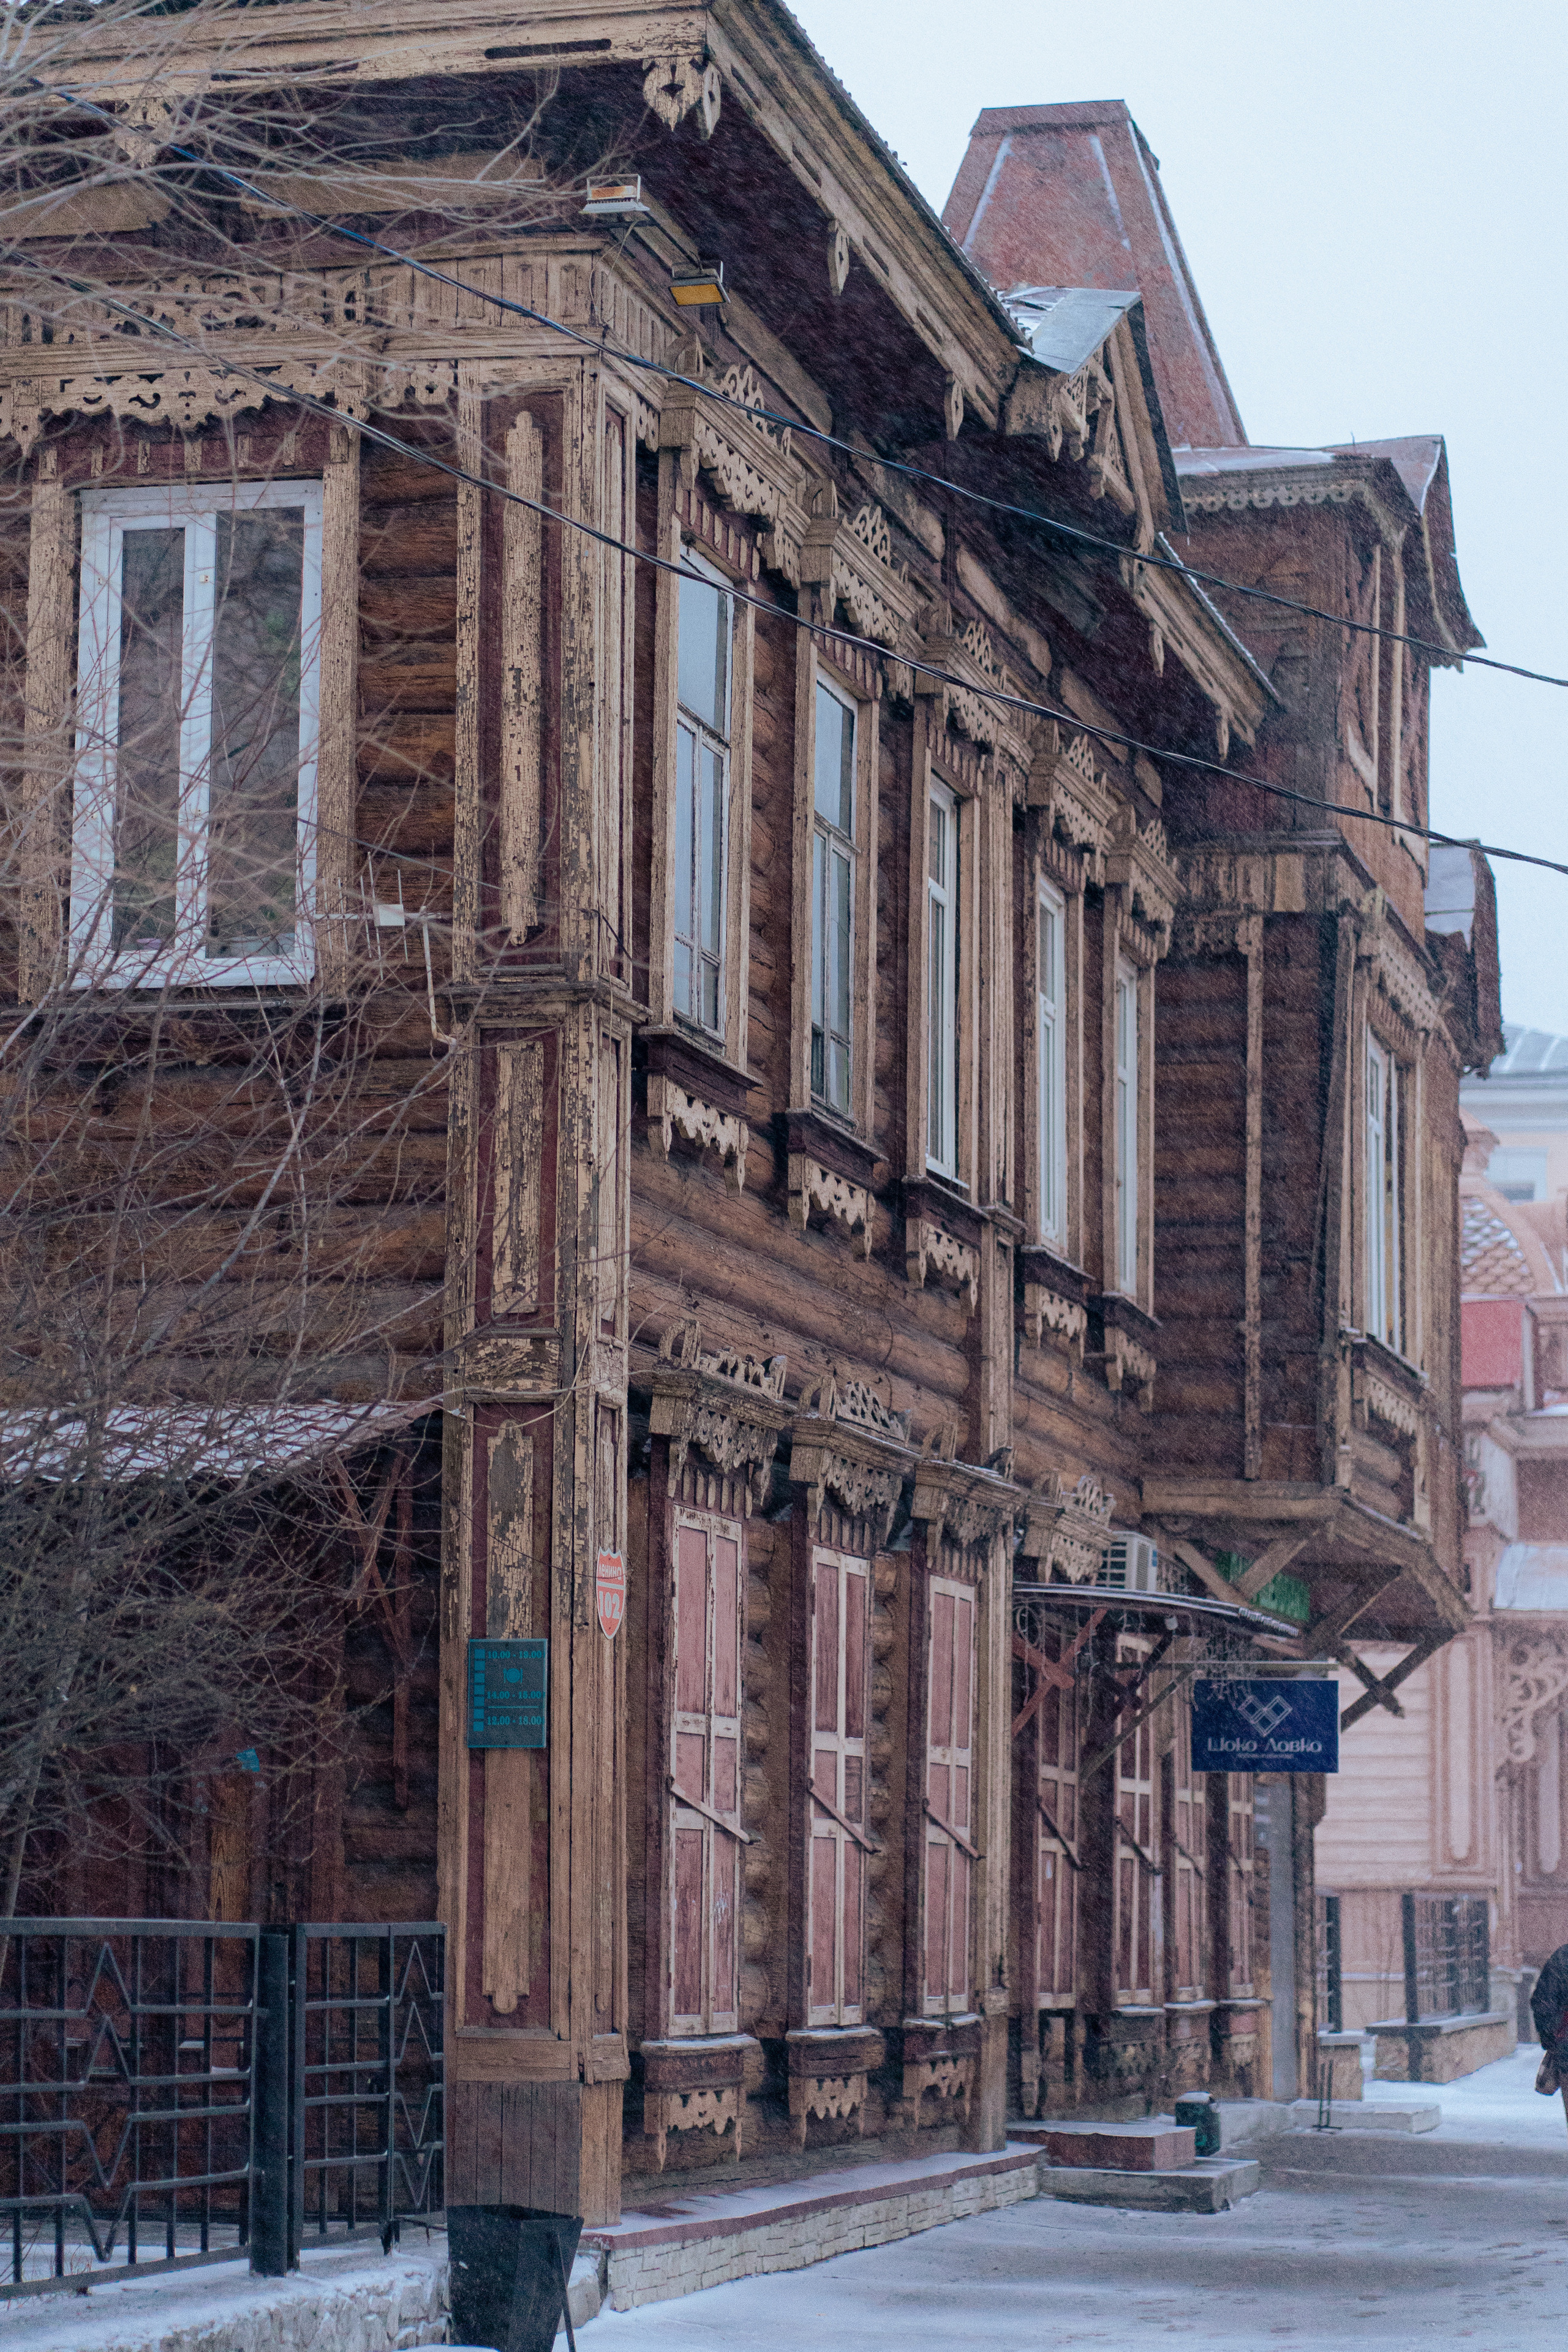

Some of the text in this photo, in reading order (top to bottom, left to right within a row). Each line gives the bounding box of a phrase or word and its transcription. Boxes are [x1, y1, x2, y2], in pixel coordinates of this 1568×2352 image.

[599, 1591, 620, 1619] 102
[488, 1650, 511, 1659] 10.00
[519, 1650, 542, 1659] 18.00
[487, 1691, 510, 1699] 14.00
[518, 1691, 541, 1699] 15.00
[487, 1716, 510, 1725] 12.00
